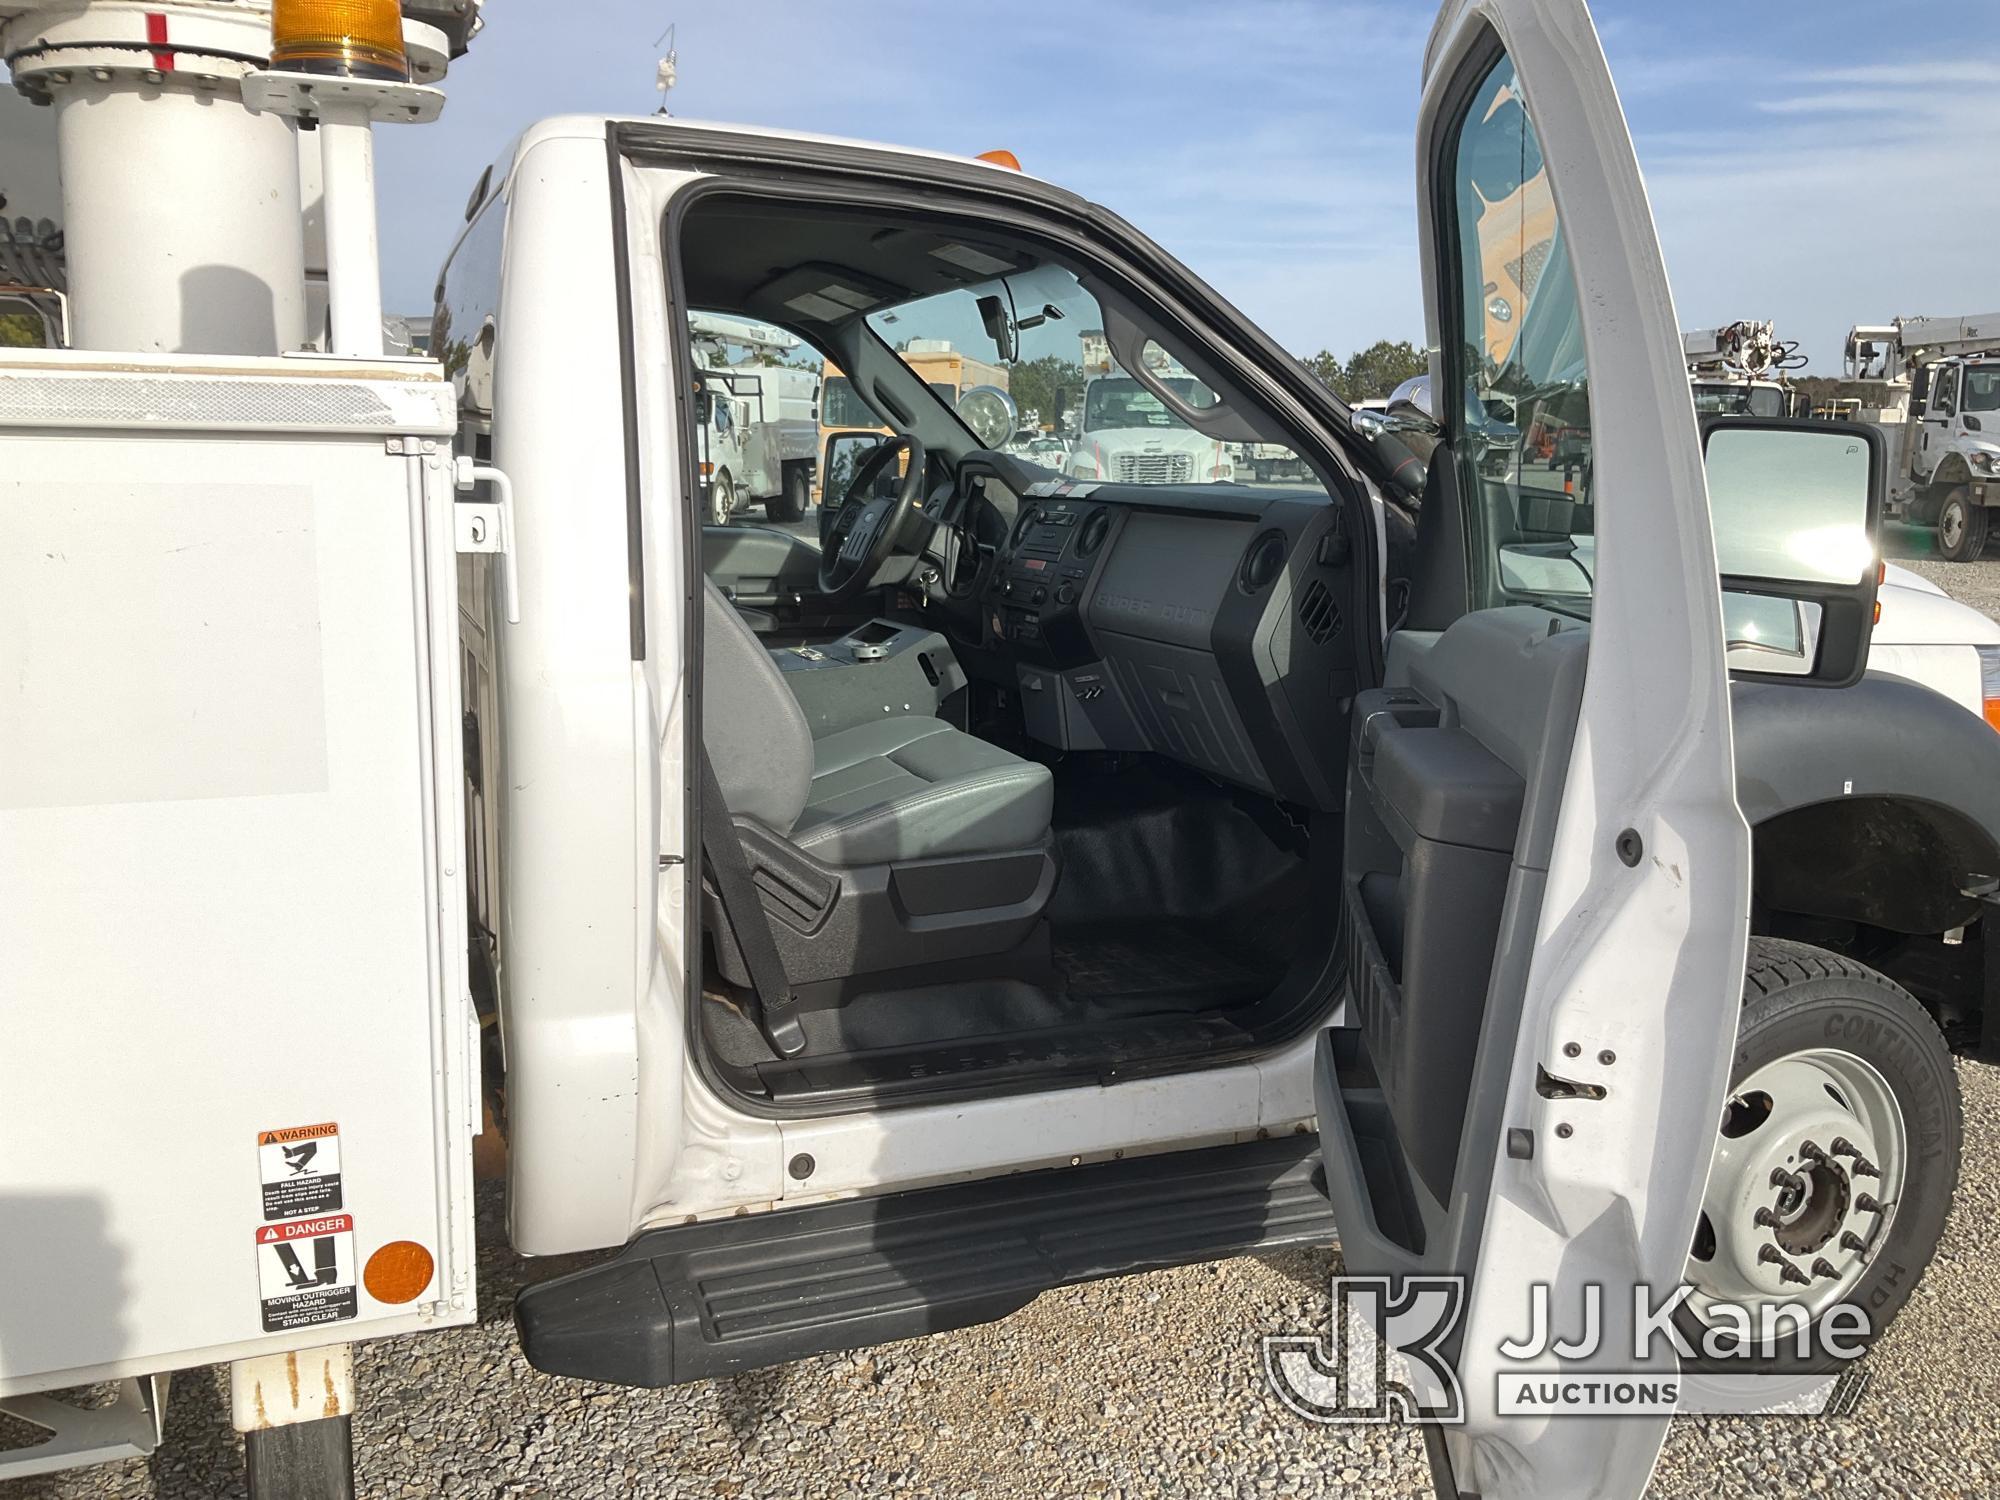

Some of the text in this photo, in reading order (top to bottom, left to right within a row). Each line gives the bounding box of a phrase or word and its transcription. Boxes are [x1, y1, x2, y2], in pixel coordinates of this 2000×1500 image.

[1824, 1013, 1943, 1158] CONTINENTAL
[280, 1125, 337, 1140] WARNING
[297, 1178, 321, 1186] HAZARD
[285, 1218, 345, 1237] DANGER
[268, 1287, 350, 1306] MOVING OUTRIGGER
[293, 1299, 326, 1309] HAZARD
[283, 1317, 310, 1326] STAND
[311, 1312, 338, 1321] CLEAR
